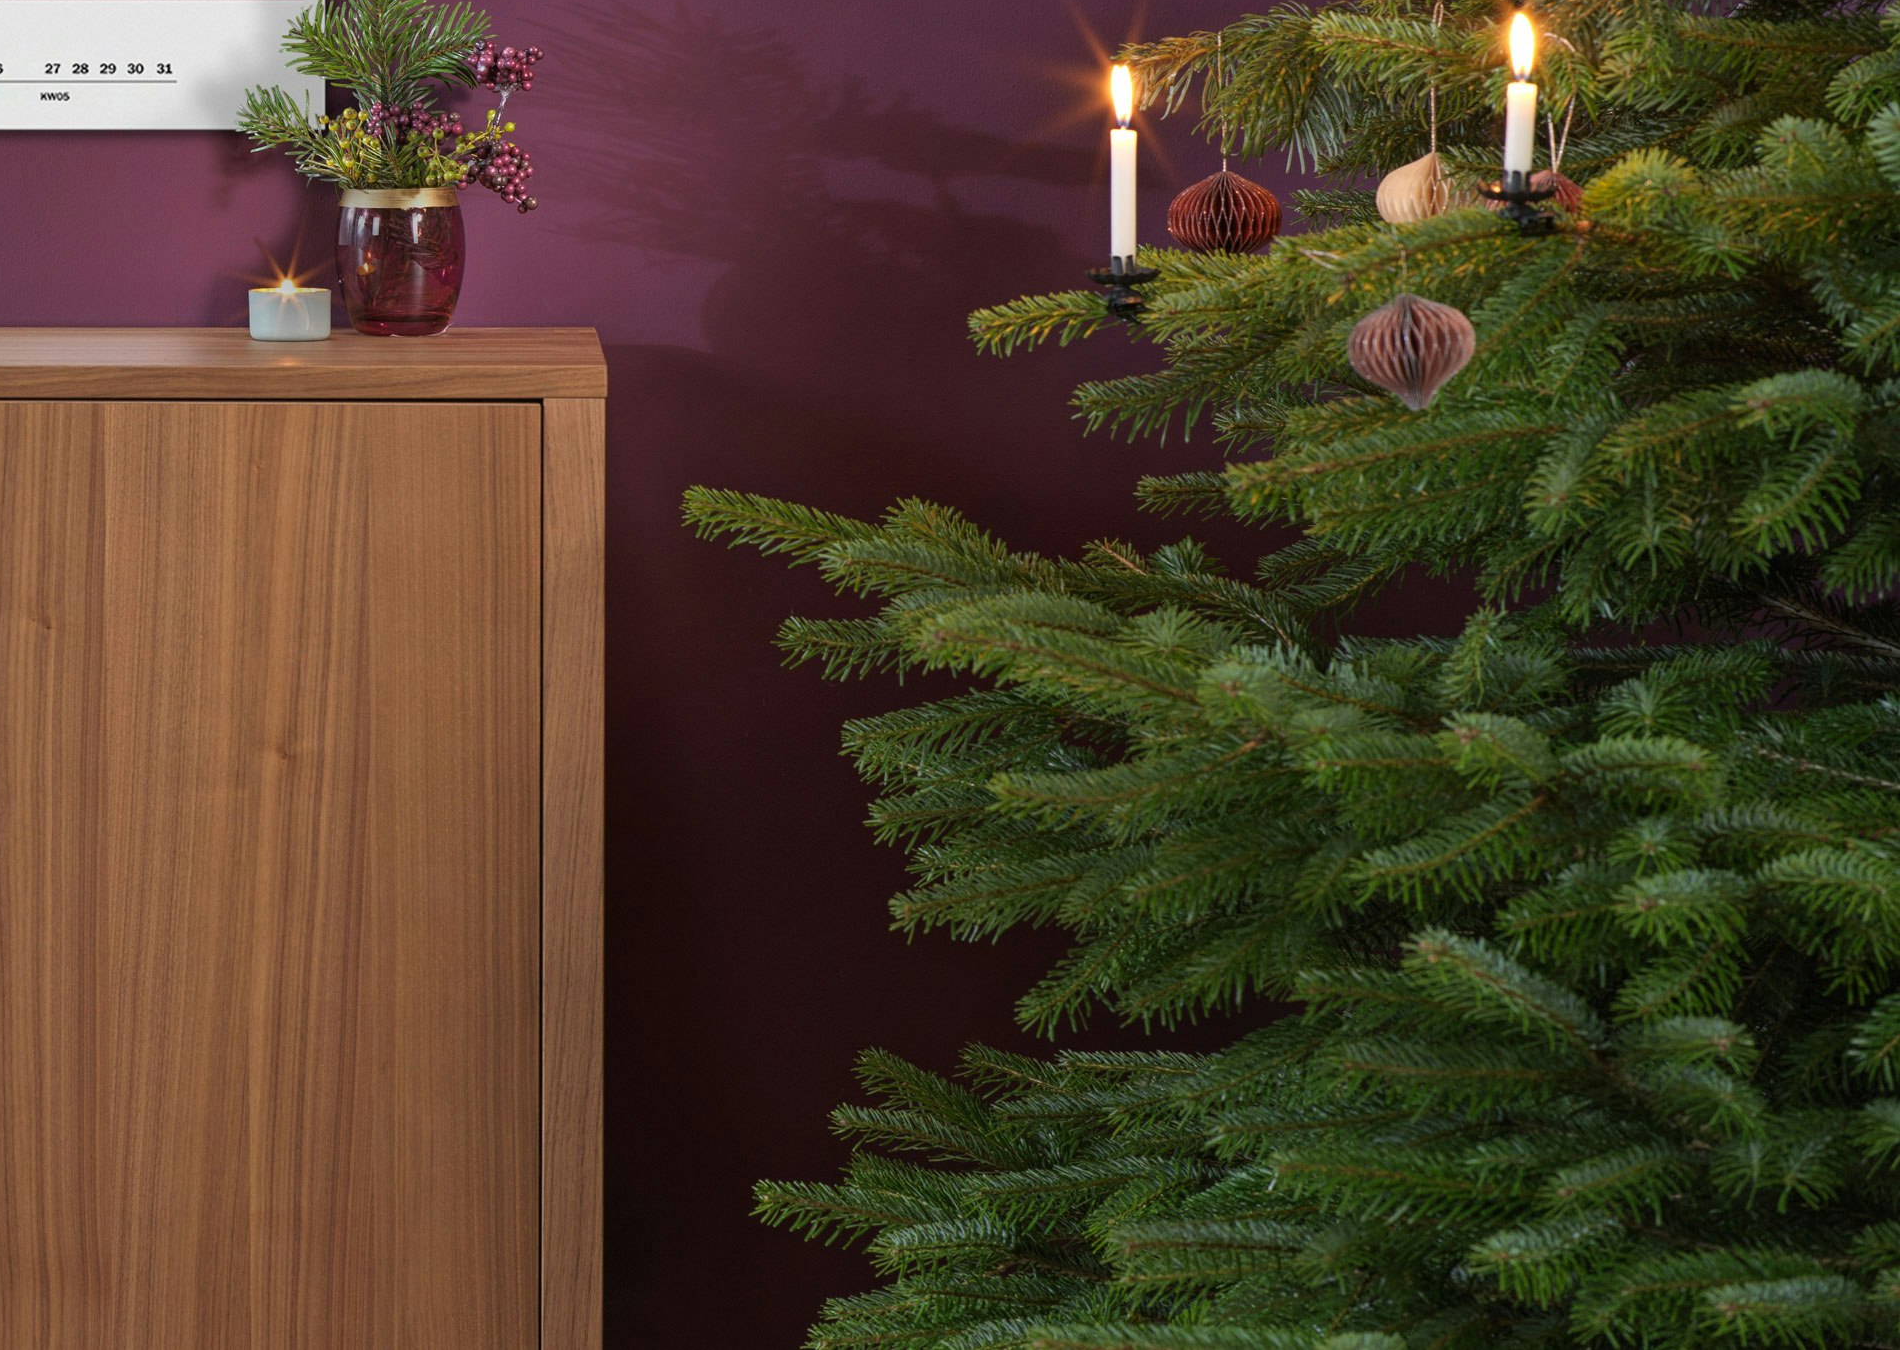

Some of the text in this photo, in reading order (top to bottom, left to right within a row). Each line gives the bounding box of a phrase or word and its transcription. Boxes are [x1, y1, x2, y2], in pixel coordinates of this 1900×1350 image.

[44, 62, 61, 75] 27
[71, 62, 90, 75] 28
[99, 62, 117, 75] 29
[127, 62, 145, 75] 30
[156, 62, 173, 75] 31
[40, 91, 71, 102] KW05
